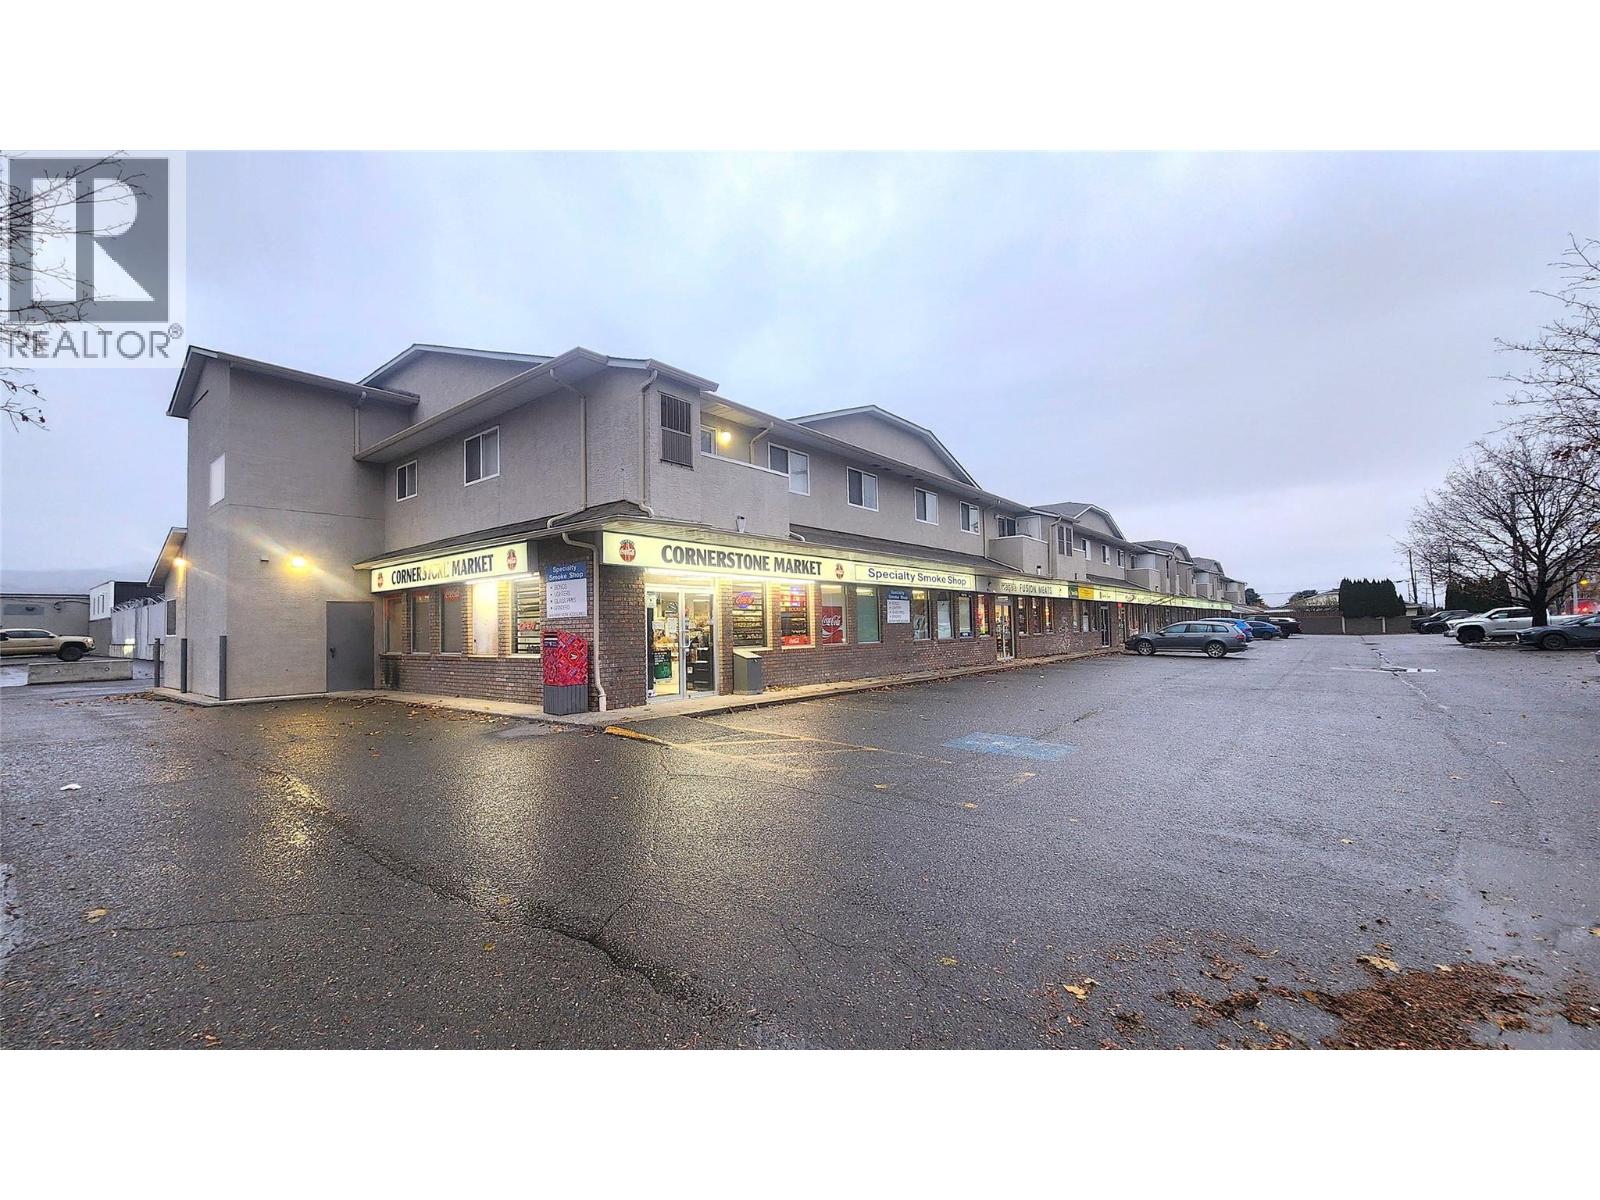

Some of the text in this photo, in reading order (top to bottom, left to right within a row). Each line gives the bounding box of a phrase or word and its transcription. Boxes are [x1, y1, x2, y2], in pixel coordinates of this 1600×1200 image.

[452, 554, 494, 576] MARKET
[661, 545, 822, 575] CORNERSTONE MARKET
[552, 564, 577, 573] Specialty
[569, 571, 584, 579] Shop
[868, 568, 967, 586] Specialty Smoke Shop
[1020, 583, 1036, 594] FUSION
[1038, 586, 1052, 595] MEATS
[518, 621, 536, 631] OPEN
